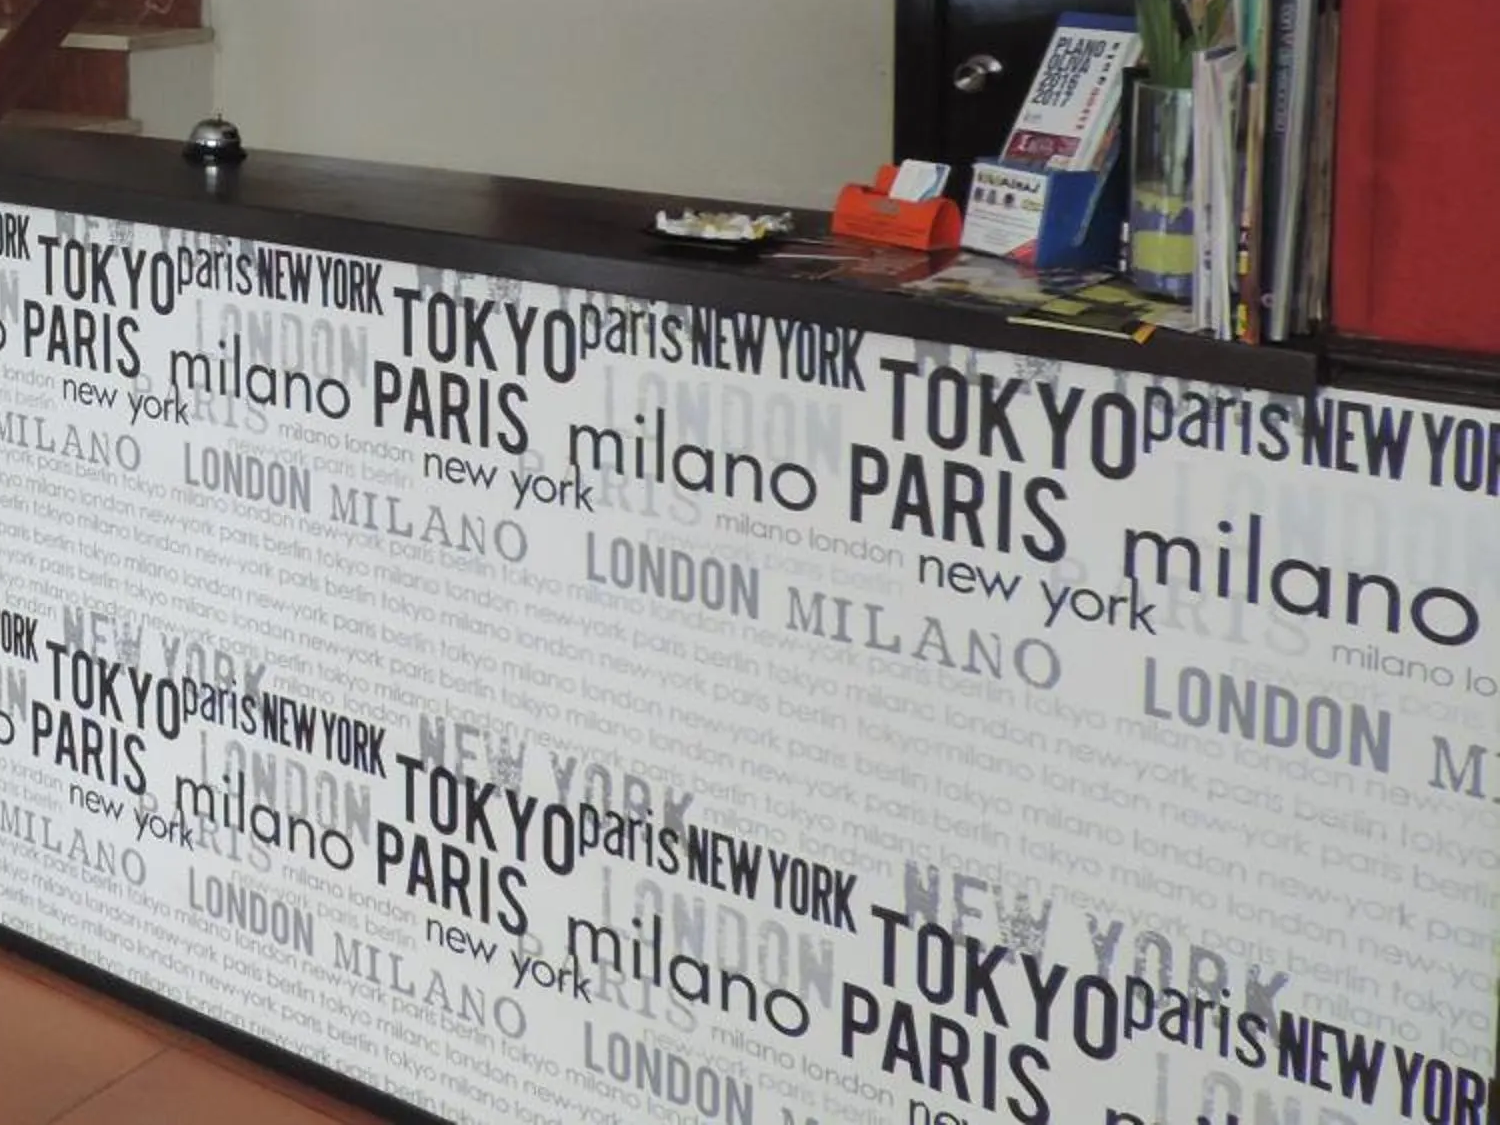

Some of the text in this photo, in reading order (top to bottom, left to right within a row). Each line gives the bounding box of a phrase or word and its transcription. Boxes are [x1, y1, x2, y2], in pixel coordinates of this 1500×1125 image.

[38, 234, 175, 317] TOKYO
[177, 240, 252, 296] paris
[258, 248, 310, 304] NEW
[318, 255, 383, 317] YORK
[24, 298, 140, 380] PARIS
[394, 286, 576, 385] TOKYO
[580, 299, 682, 363] paris
[691, 308, 764, 376] NEW
[774, 320, 866, 394] YORK
[62, 377, 187, 426] new york
[171, 330, 529, 457] milano PARIS
[880, 358, 1139, 483] TOKYO
[1142, 383, 1290, 461] paris
[1302, 396, 1409, 480] NEW
[1422, 411, 1500, 497] YO
[184, 441, 527, 566] LONDON MILANO
[424, 450, 592, 512] new york
[570, 402, 1068, 565] milano PARIS
[717, 514, 904, 568] milano london
[918, 552, 1156, 634] new york
[1123, 506, 1480, 650] milano
[586, 530, 1063, 694] LONDON MILANO
[46, 639, 181, 743] TOKYO
[1142, 656, 1391, 774] LONDON
[1332, 646, 1453, 689] milano
[32, 698, 147, 798] PARIS
[182, 674, 387, 779] paris NEW YORK
[0, 797, 146, 890] MILANO
[70, 781, 193, 851] new york
[176, 763, 529, 941] milano PARIS
[396, 752, 576, 880] TOKYO
[579, 800, 858, 935] paris NEW YORK
[188, 865, 527, 1045] LONDON MILANO
[425, 915, 590, 1004] new york
[868, 903, 1121, 1067] TOKYO
[568, 904, 809, 1044] milano
[841, 980, 1053, 1125] PARIS
[1123, 972, 1266, 1070] paris
[1277, 1009, 1381, 1107] NEW
[1394, 1044, 1498, 1125] YOR
[584, 1019, 753, 1125] LONDON
[712, 1027, 894, 1109] milano london
